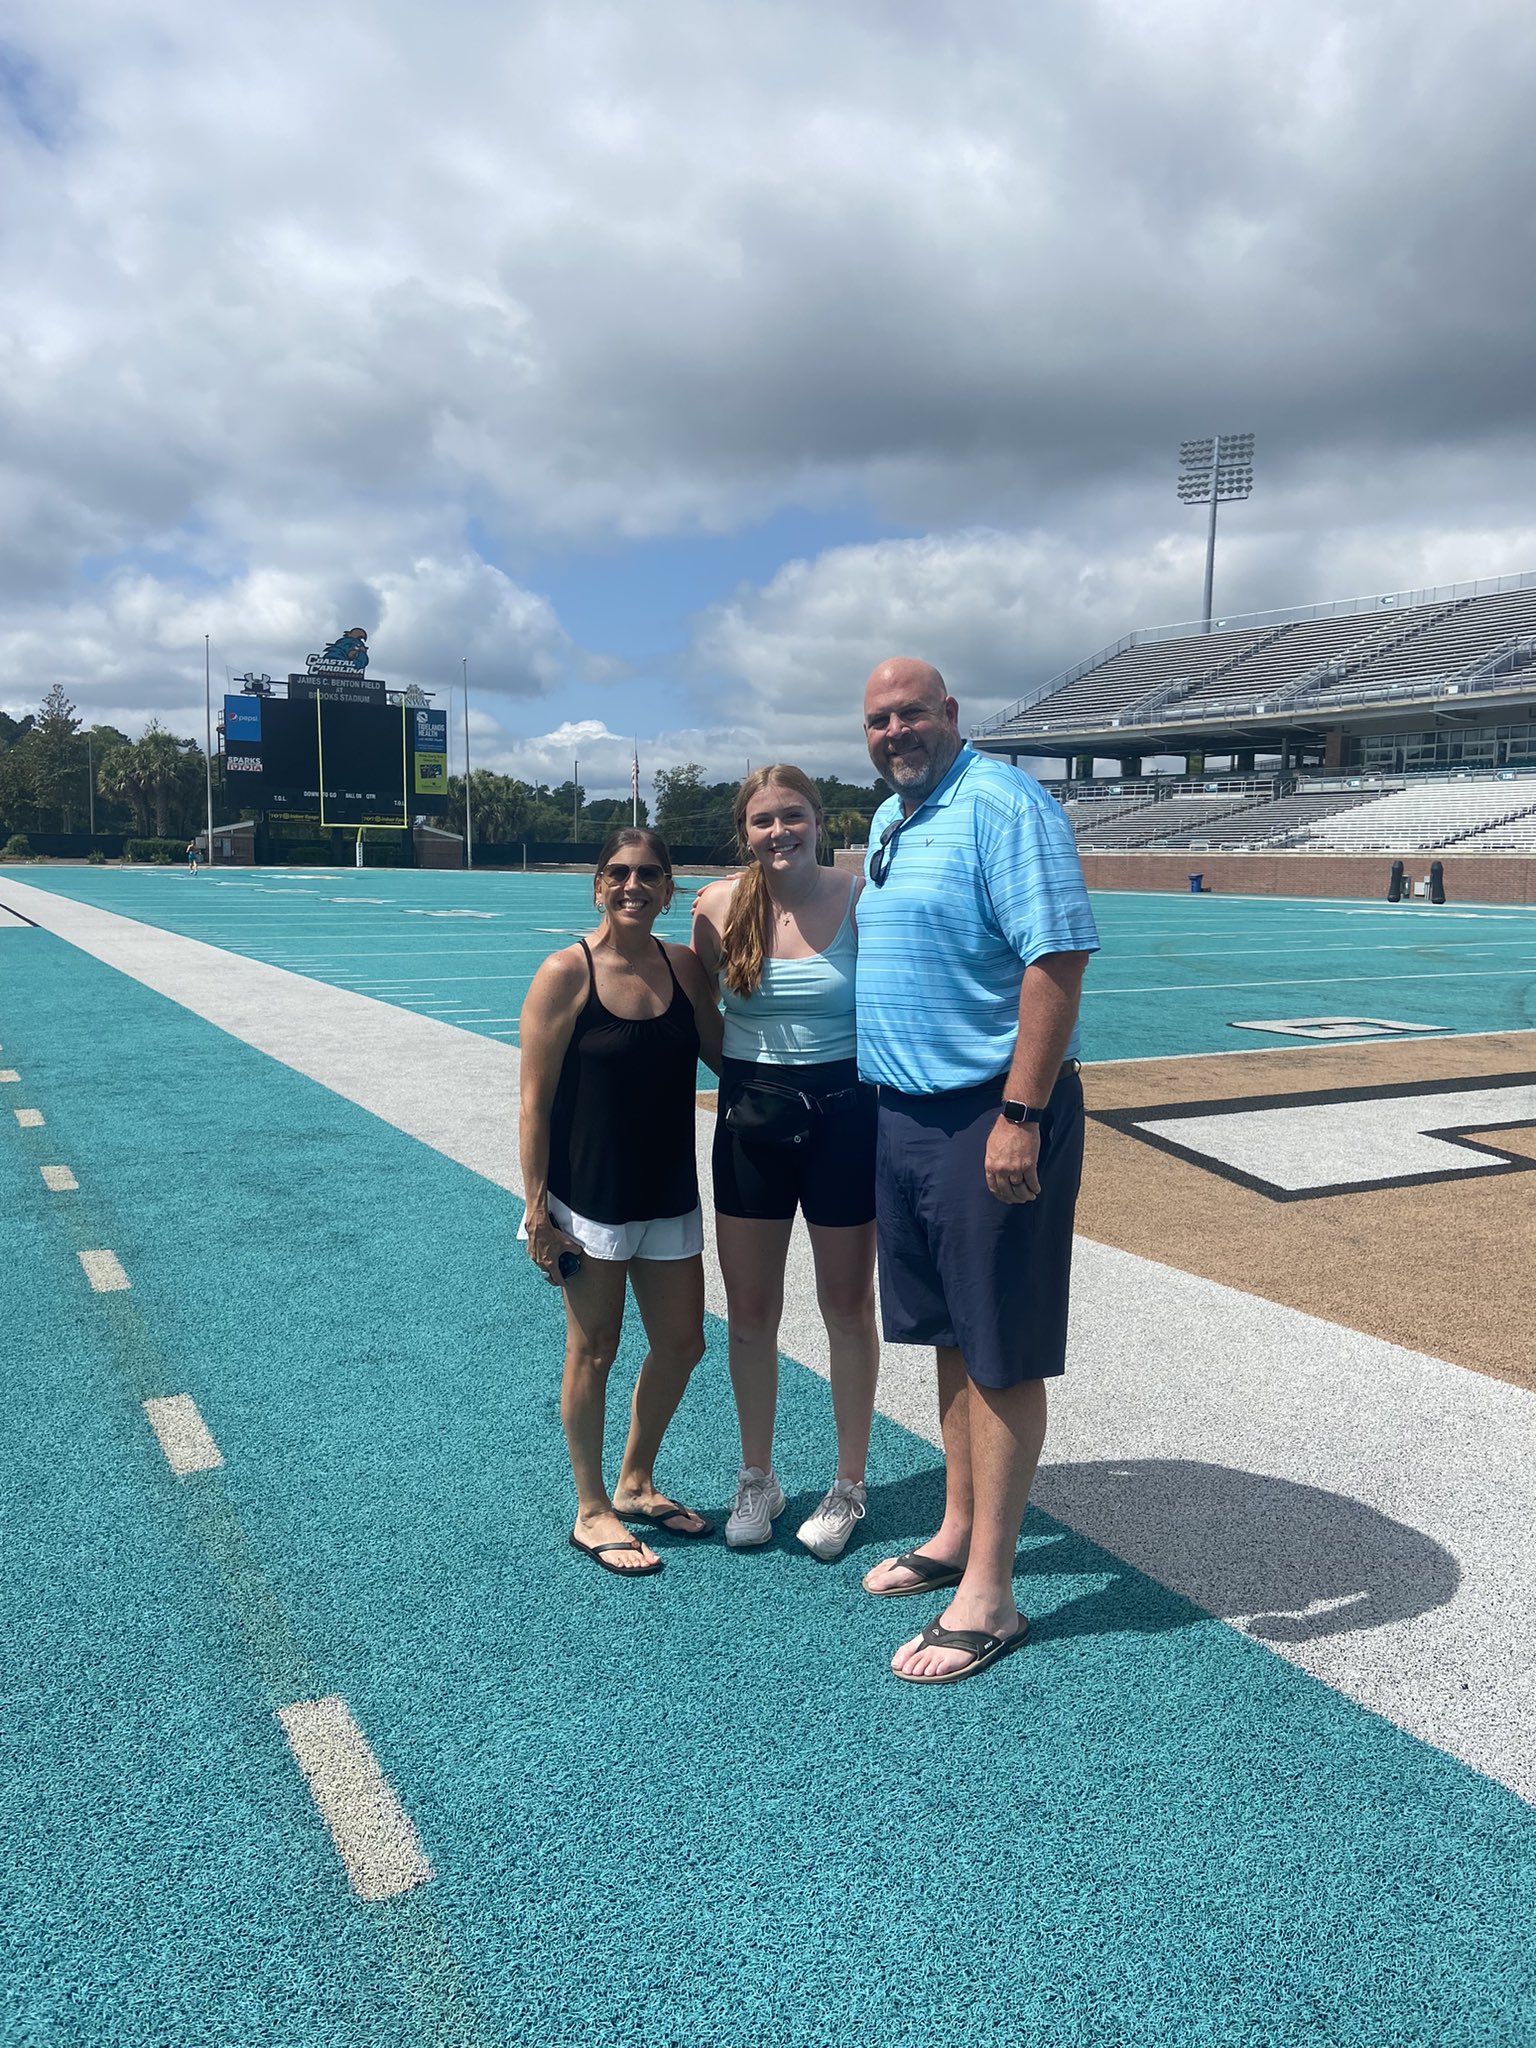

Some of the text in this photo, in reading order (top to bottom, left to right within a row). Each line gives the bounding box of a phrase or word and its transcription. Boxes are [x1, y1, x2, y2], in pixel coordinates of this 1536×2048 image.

[307, 655, 356, 667] COASTAL
[309, 664, 364, 675] CAROLINA
[297, 675, 380, 690] JAMES C. BENTON FIELD
[340, 694, 370, 703] STADIUM
[238, 715, 258, 723] pepsi
[417, 723, 445, 732] TIDELANDS
[418, 730, 438, 738] HEALTH
[227, 756, 261, 765] SPARKS
[227, 763, 263, 772] TOYOTA
